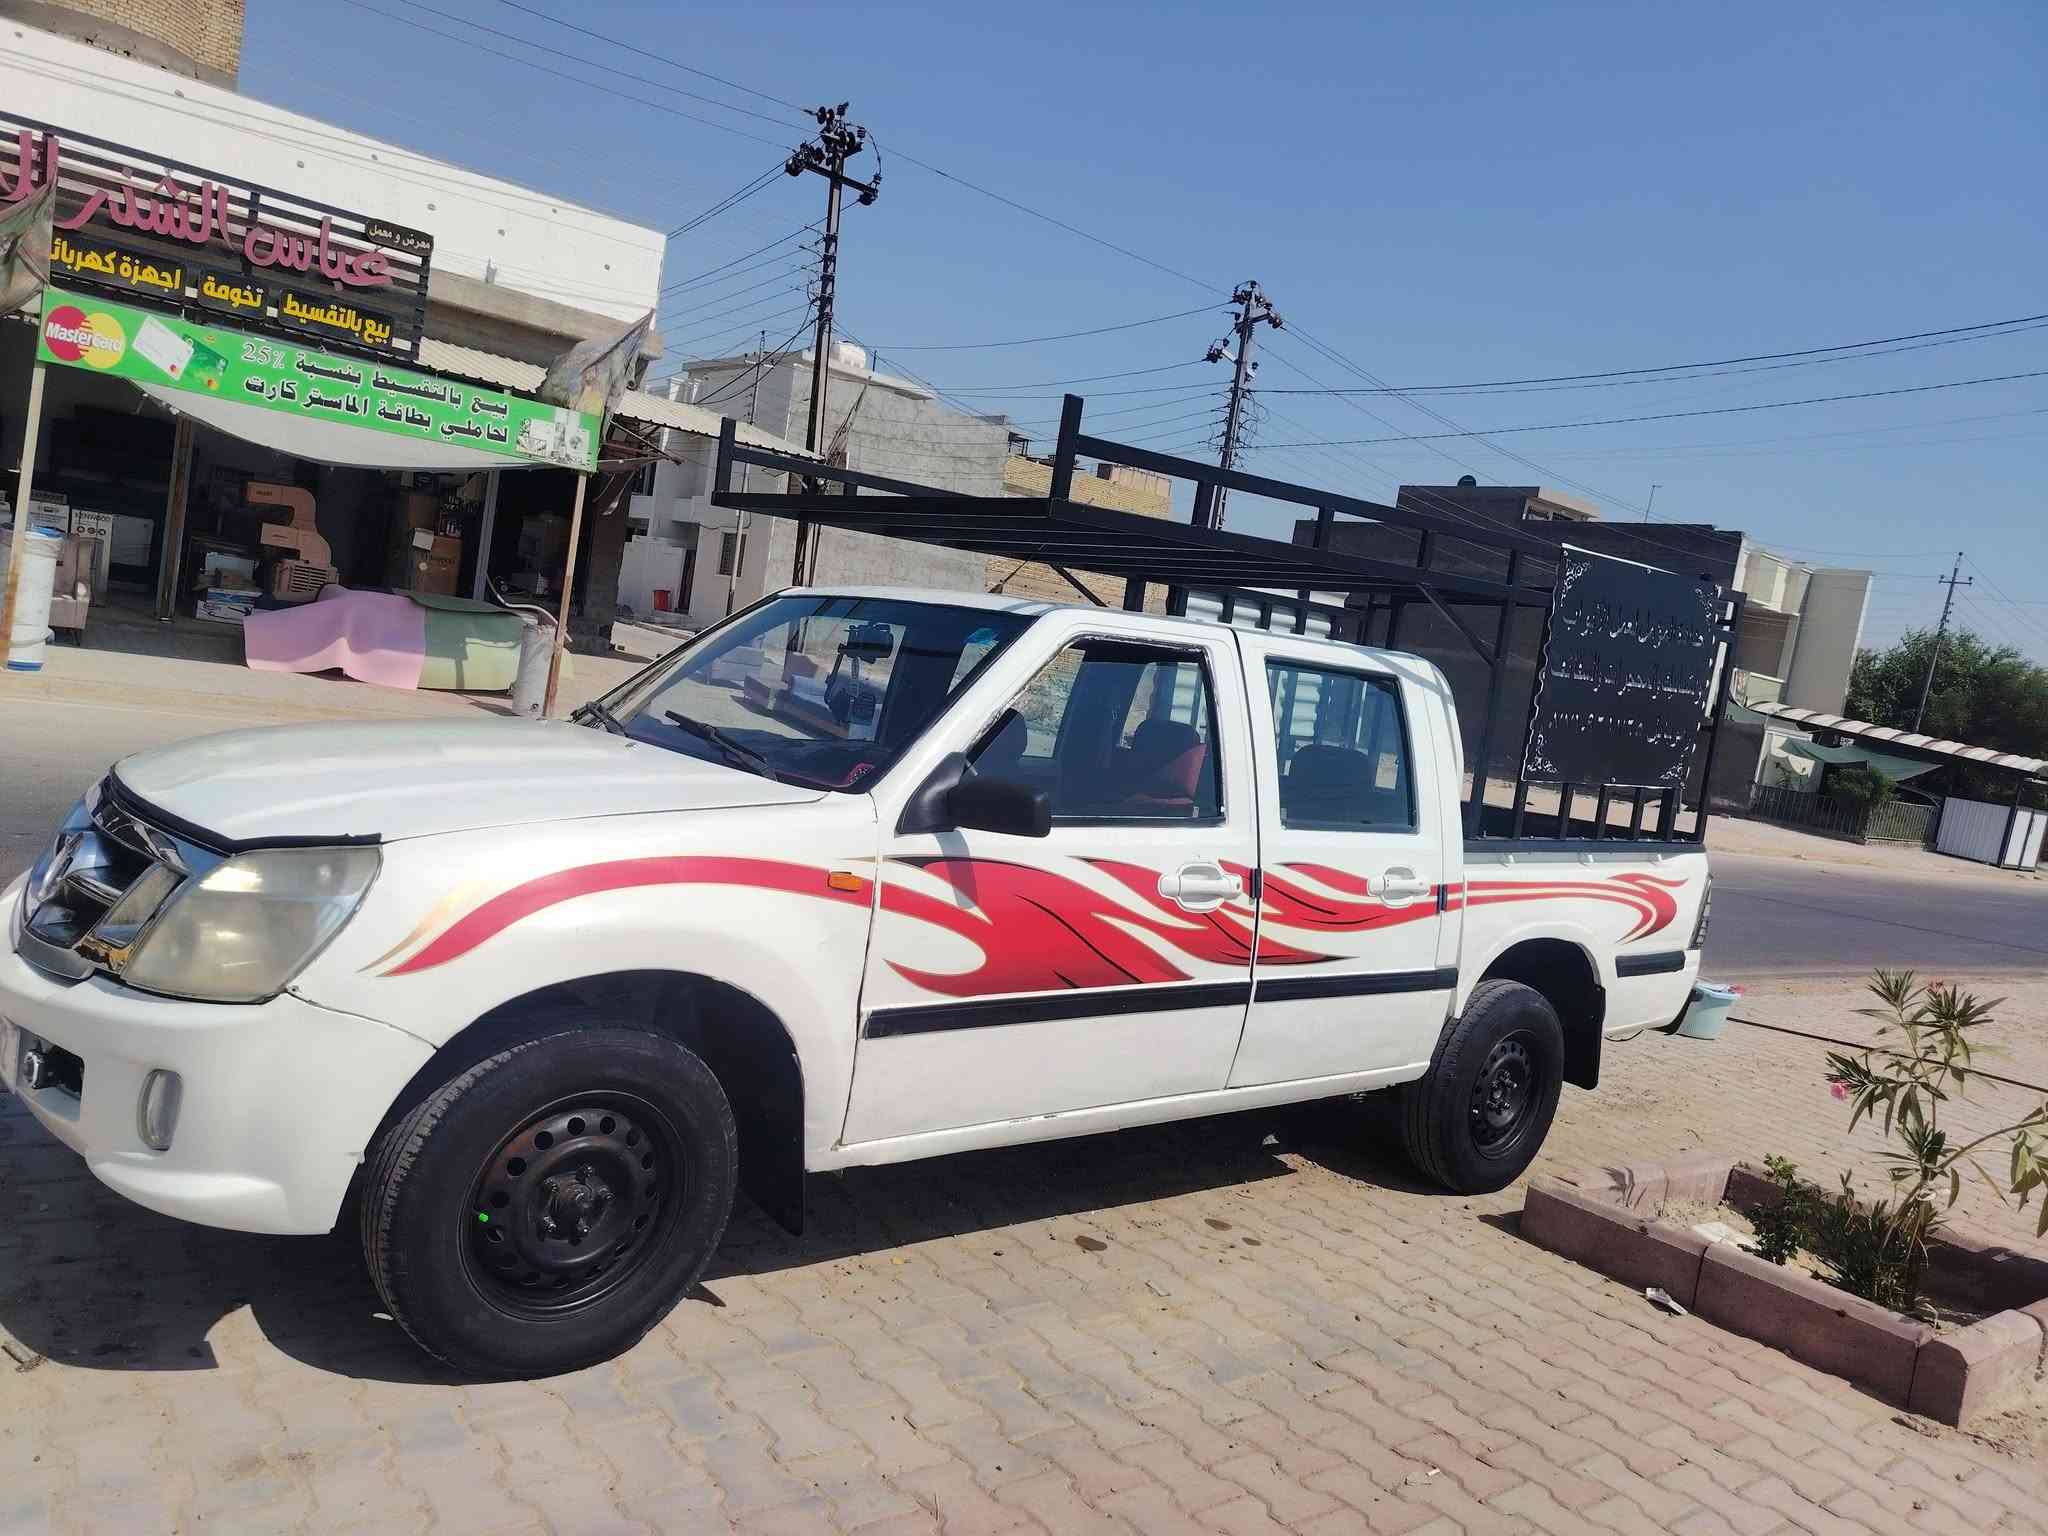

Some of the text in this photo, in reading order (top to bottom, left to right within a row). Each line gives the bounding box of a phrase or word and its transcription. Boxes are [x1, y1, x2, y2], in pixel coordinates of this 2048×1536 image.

[48, 237, 116, 272] كهربائ
[244, 216, 392, 292] عباس
[369, 224, 430, 249] معرض و معمل
[120, 255, 181, 293] اجهزة
[284, 293, 362, 337] بالتقسيط
[363, 318, 390, 344] بيع
[296, 352, 361, 389] بنسبة
[372, 370, 462, 409] بالتقسيط
[244, 376, 508, 443] لحاملي بطاقة الماستر كارت
[471, 397, 507, 420] بيع
